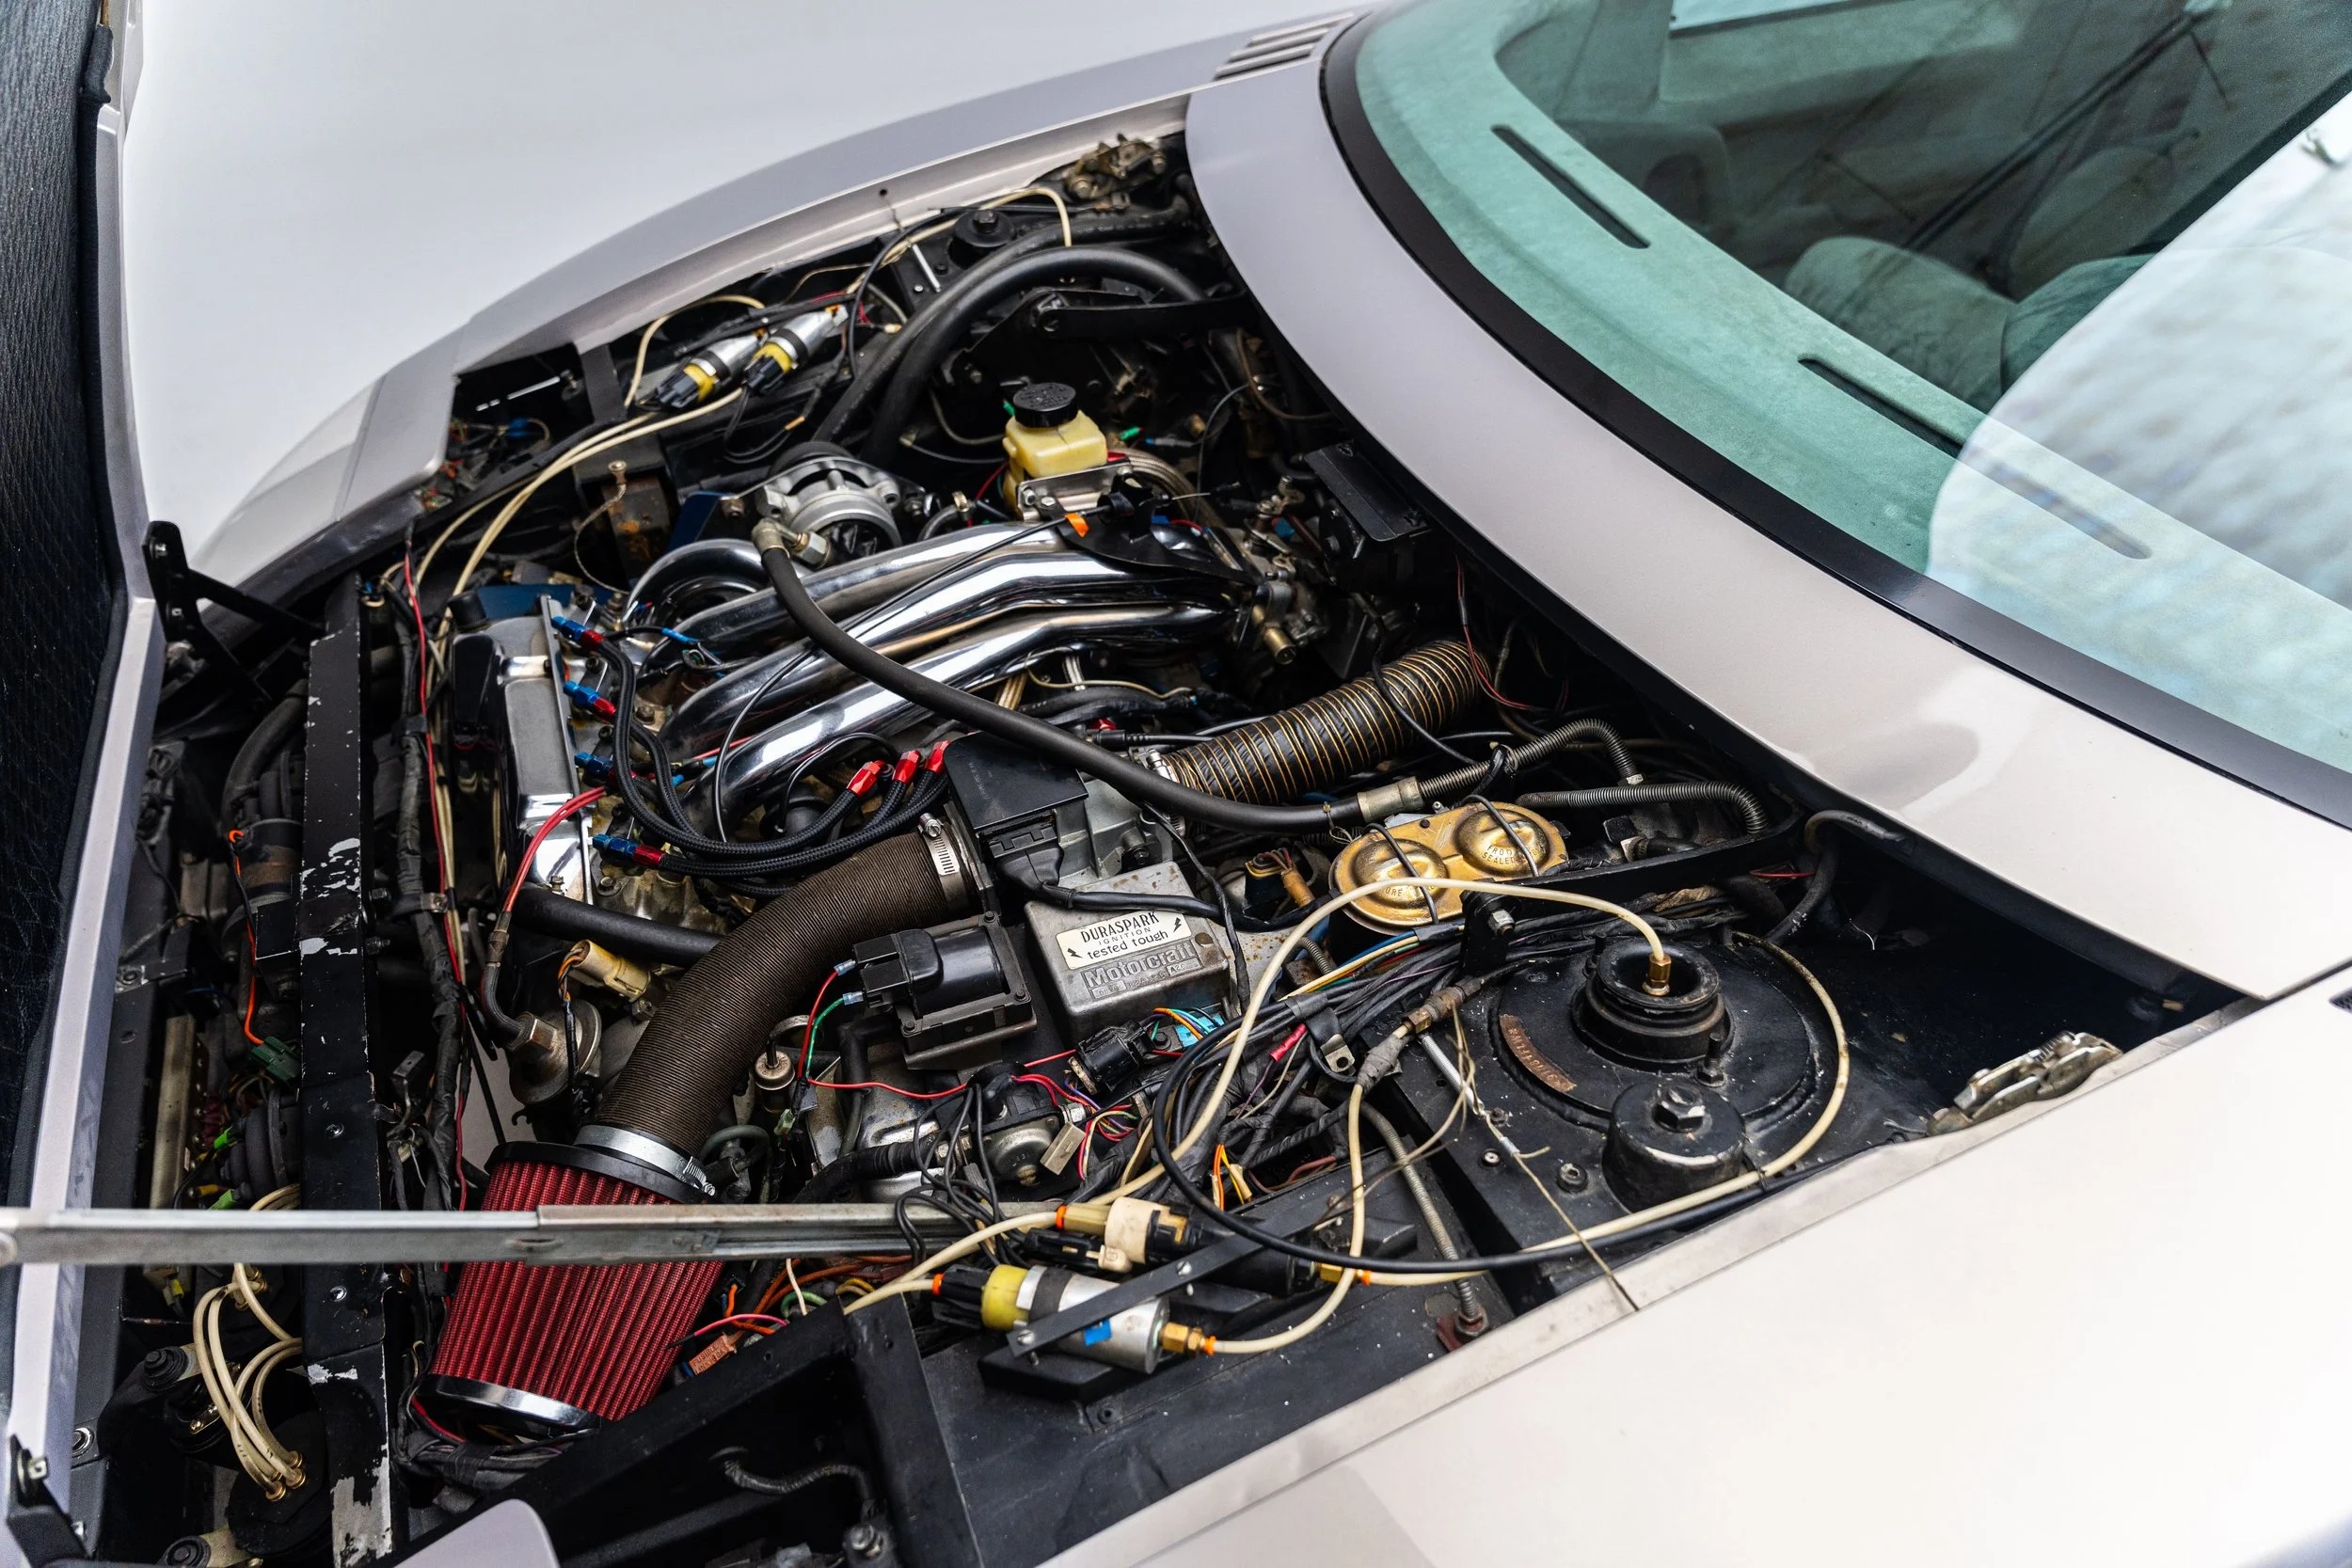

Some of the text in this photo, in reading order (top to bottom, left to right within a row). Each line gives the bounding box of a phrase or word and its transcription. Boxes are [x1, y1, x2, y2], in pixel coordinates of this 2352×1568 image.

[1081, 911, 1159, 942] DURASPARK
[1098, 927, 1152, 945] IGNITION
[1087, 930, 1168, 959] tested tough
[1084, 942, 1195, 988] Motorcraft
[692, 1344, 719, 1367] FUSIBLE
